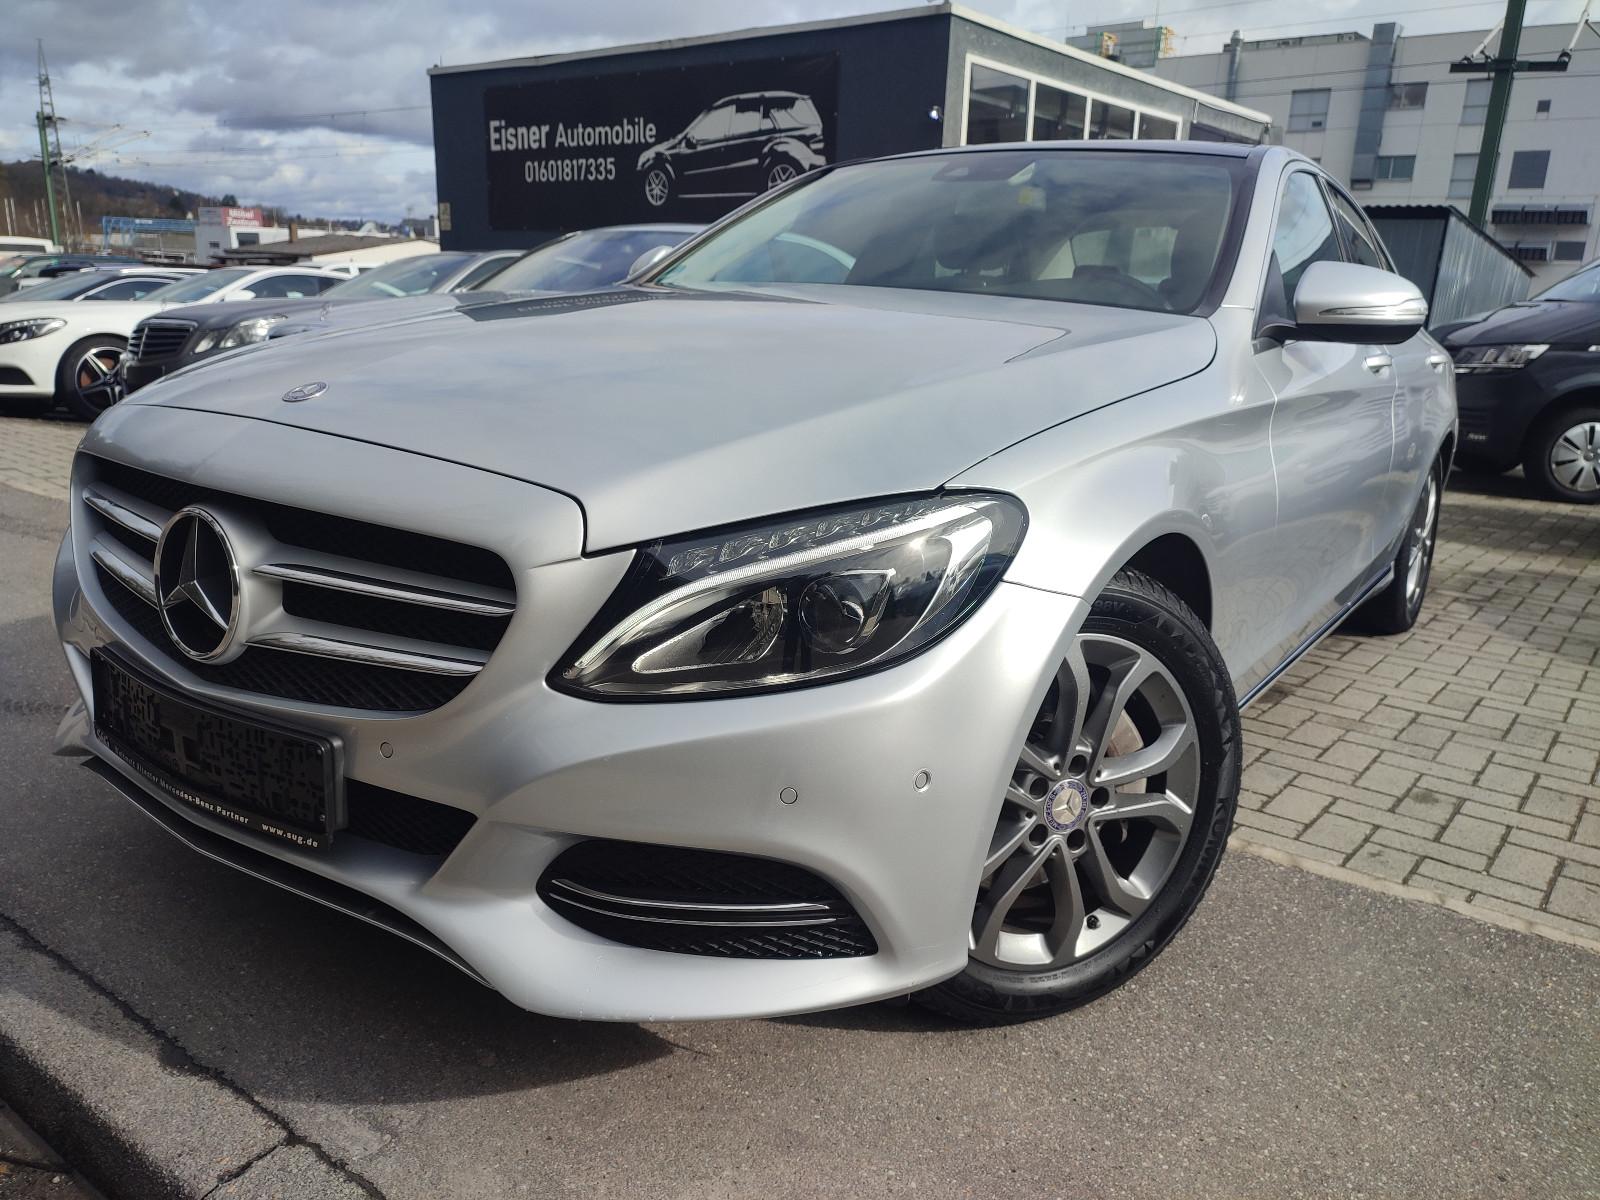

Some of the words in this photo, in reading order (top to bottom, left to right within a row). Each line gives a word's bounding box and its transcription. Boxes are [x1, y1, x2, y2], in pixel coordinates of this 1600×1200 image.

[489, 120, 550, 151] Eisner
[555, 117, 657, 148] Automobile
[525, 157, 616, 183] 01601817335
[160, 778, 214, 811] Mercedes-Benz
[216, 805, 249, 824] Partner
[261, 823, 318, 848] www.sug.de
